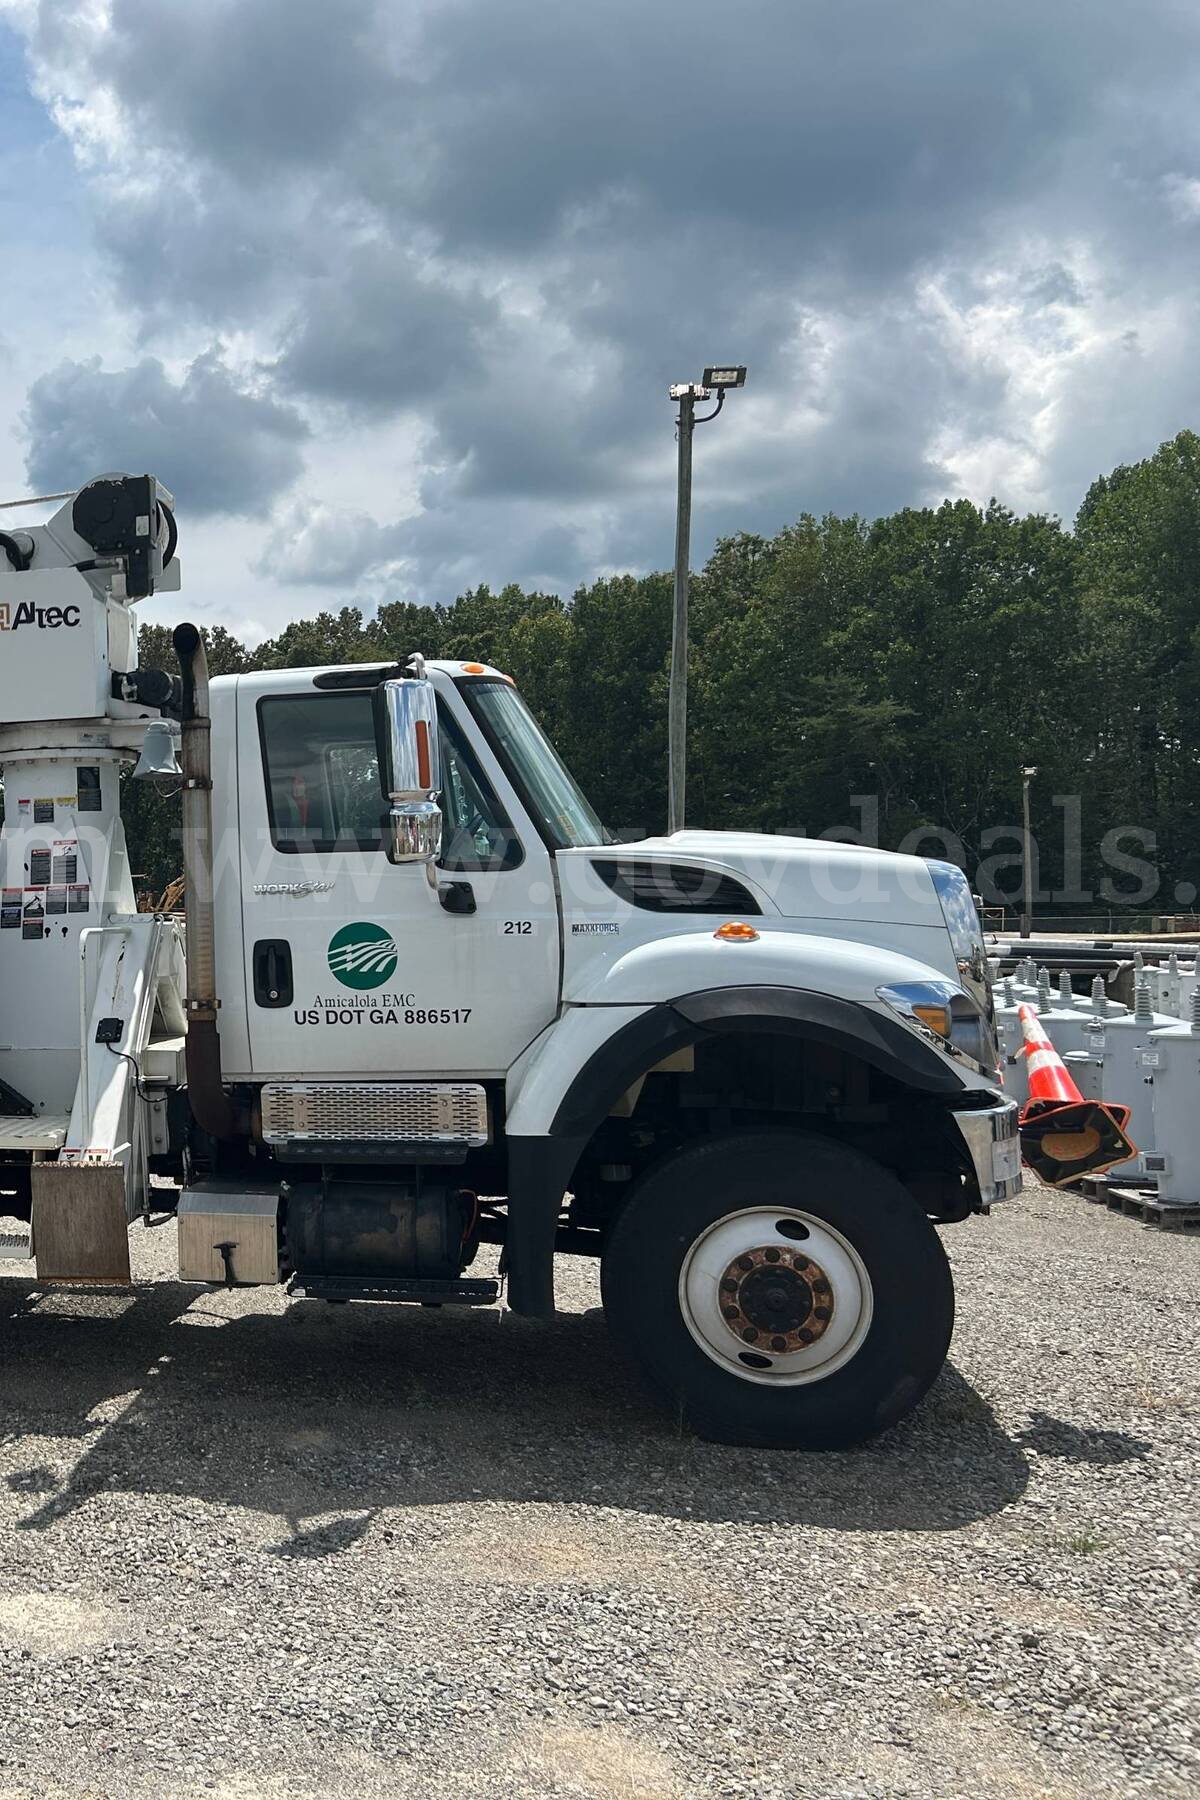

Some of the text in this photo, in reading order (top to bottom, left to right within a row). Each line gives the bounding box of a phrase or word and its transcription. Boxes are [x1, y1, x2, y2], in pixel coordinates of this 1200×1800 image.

[11, 602, 81, 630] Altec
[504, 921, 532, 934] 212
[313, 994, 416, 1008] Amicalola EMC
[294, 1008, 472, 1025] US DOT GA 886517
